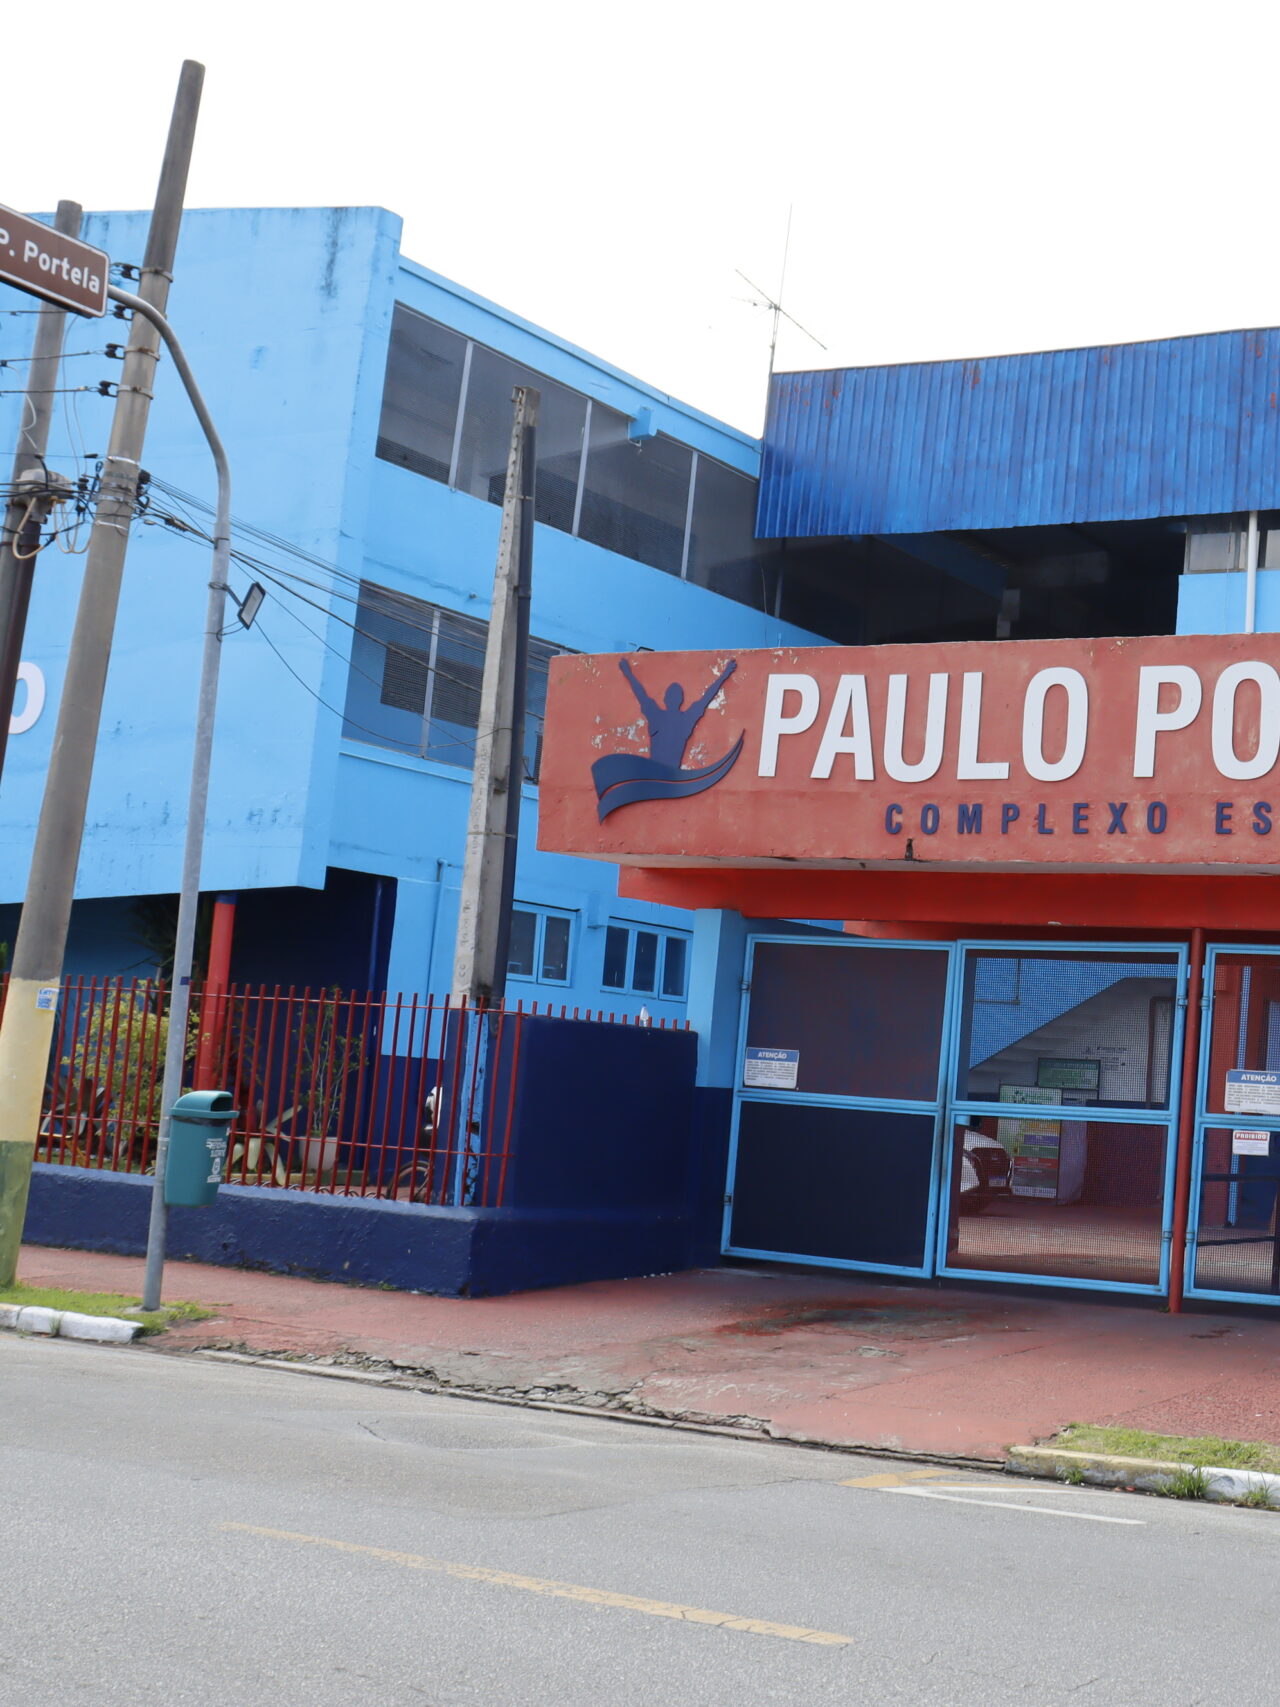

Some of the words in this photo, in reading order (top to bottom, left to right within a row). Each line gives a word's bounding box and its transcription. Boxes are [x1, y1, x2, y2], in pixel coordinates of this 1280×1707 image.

[23, 240, 100, 294] Portela
[757, 665, 1089, 783] PAULO
[884, 800, 1168, 836] COMPLEXO
[757, 1051, 788, 1060] ATENÇÃO
[1240, 1073, 1277, 1083] ATENÇÃO
[1235, 1132, 1267, 1140] PROIBIDO
